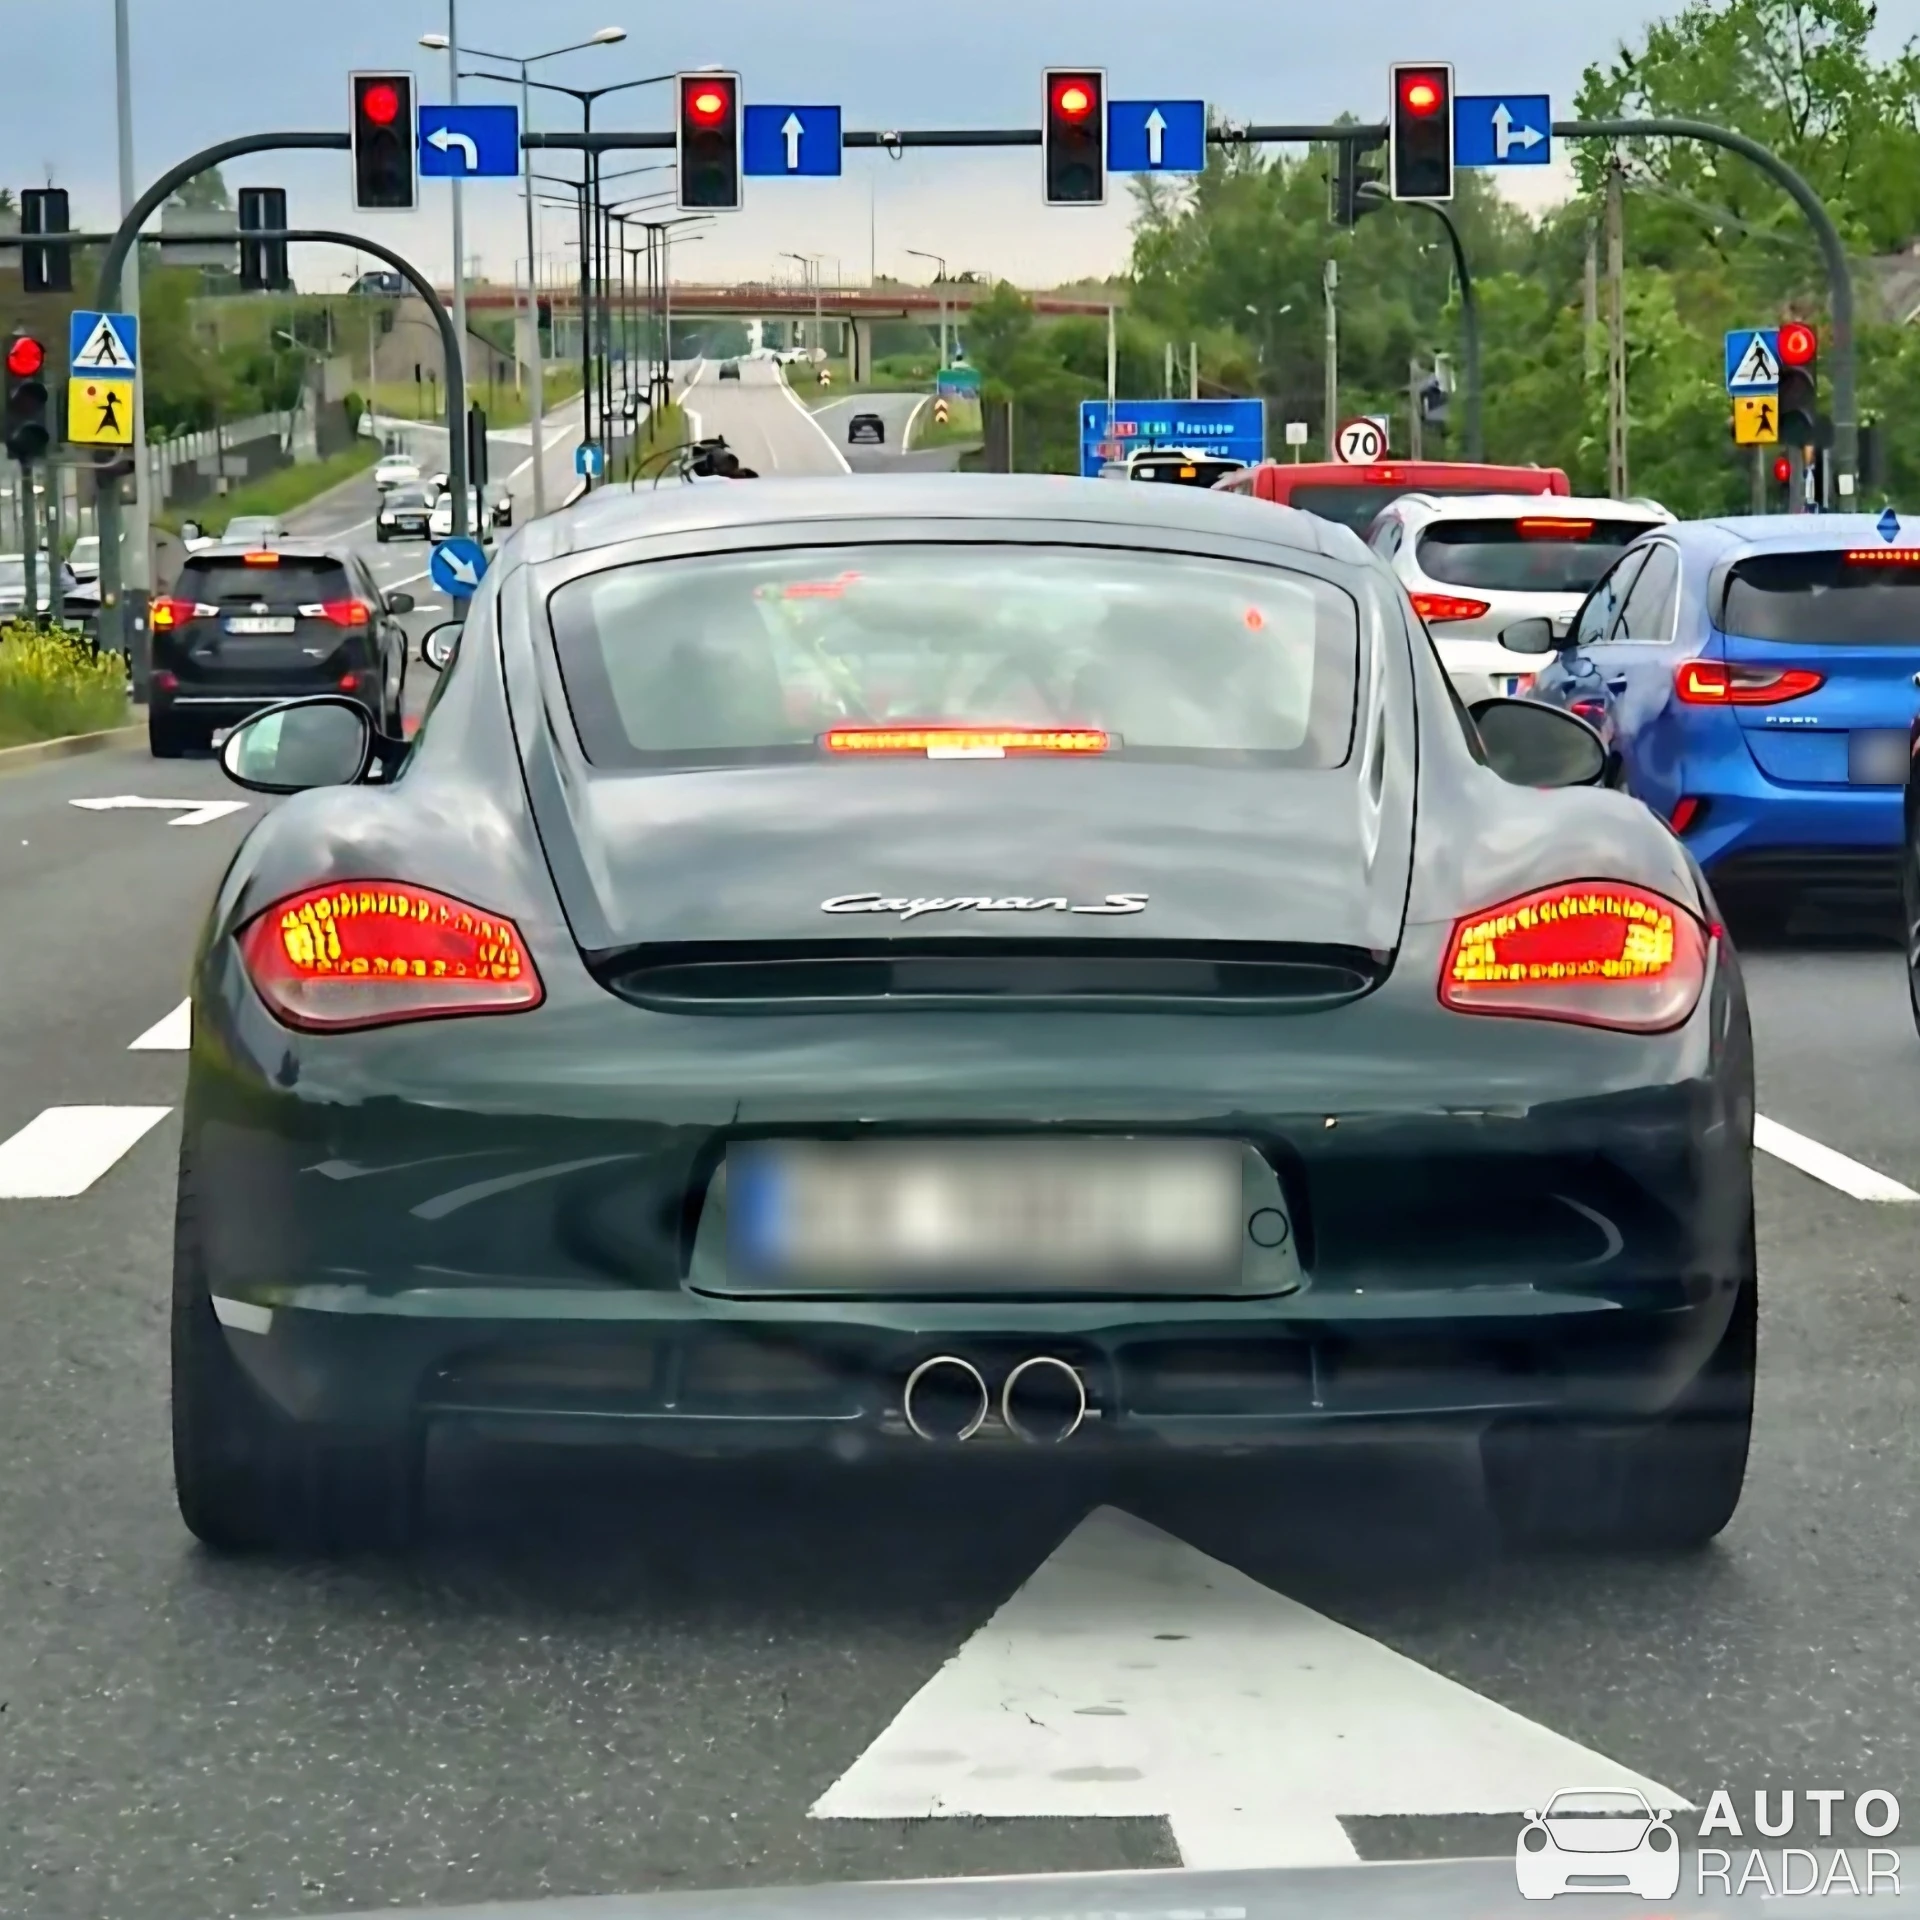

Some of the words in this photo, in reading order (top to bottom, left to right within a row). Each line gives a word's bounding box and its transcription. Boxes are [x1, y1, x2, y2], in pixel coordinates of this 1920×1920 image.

[1346, 432, 1377, 456] 70
[821, 892, 1068, 921] Cayman
[1071, 893, 1149, 913] S
